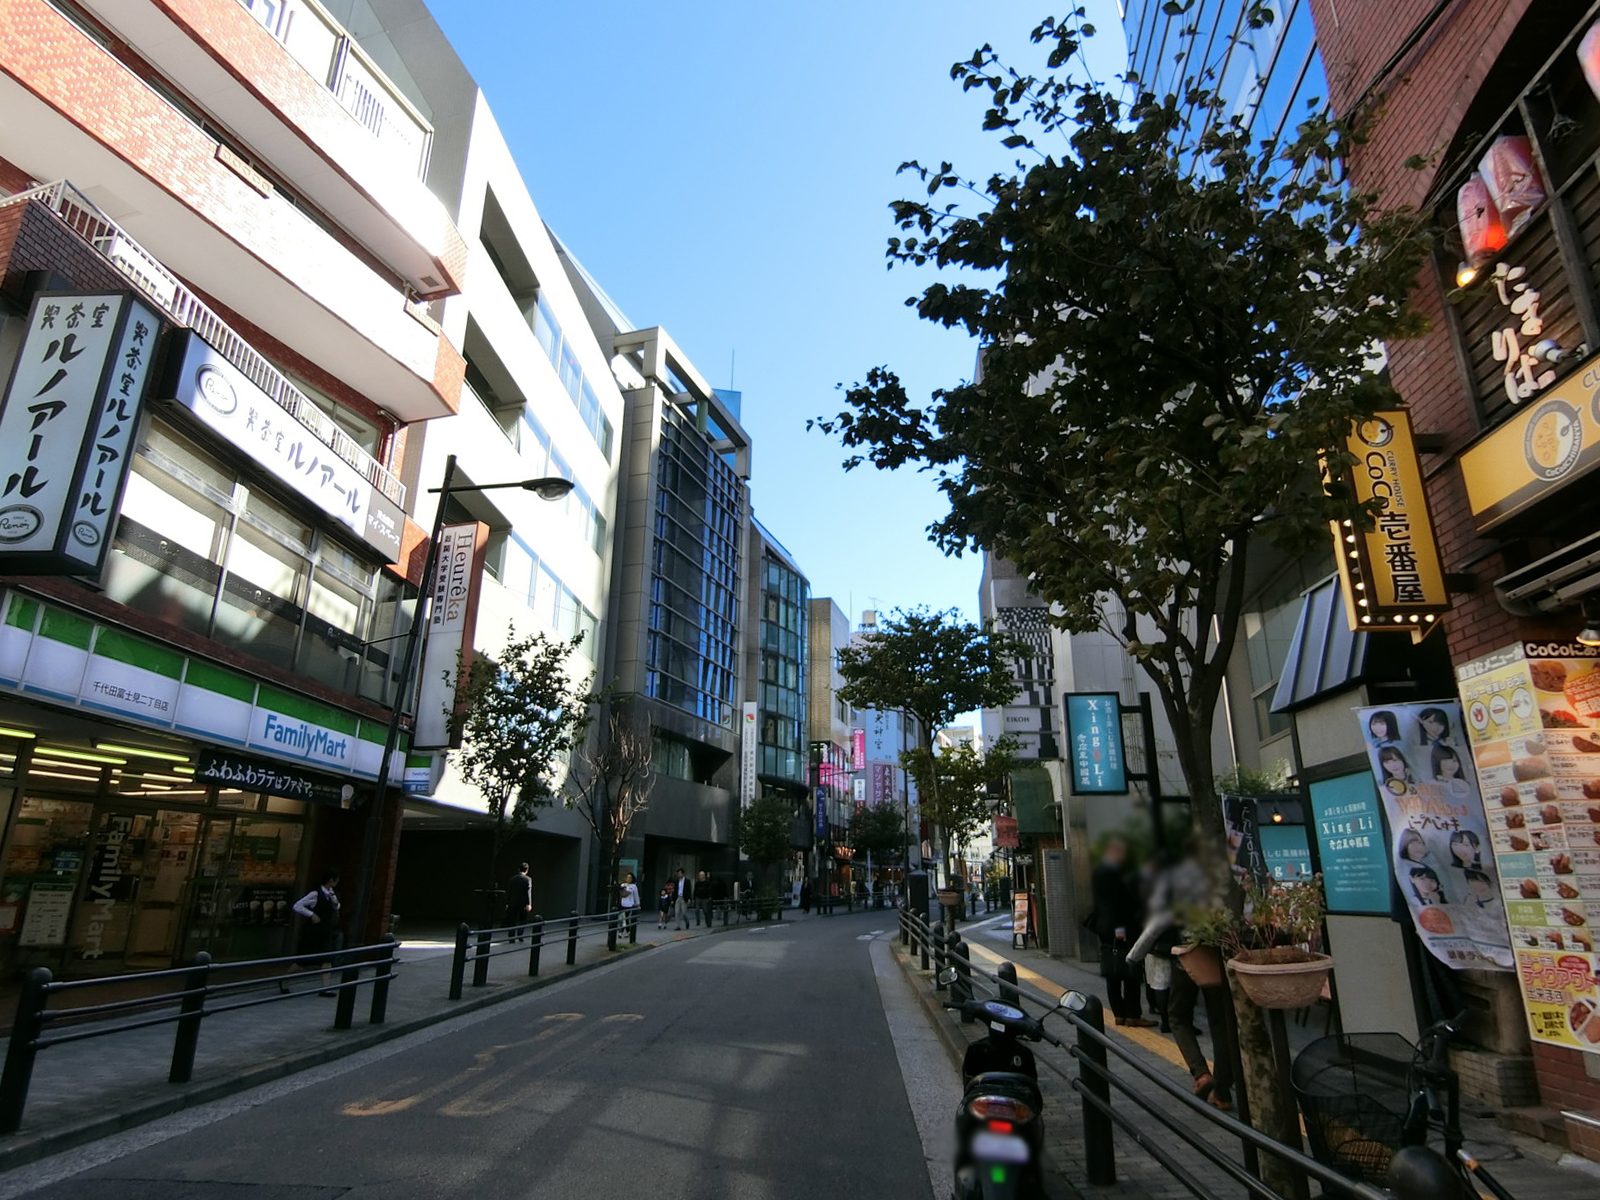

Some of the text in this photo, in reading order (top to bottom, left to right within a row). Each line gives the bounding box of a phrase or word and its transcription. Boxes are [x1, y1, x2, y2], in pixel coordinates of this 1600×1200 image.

[40, 302, 110, 330] 喫茶室
[2, 333, 87, 499] ルノアール
[1386, 450, 1405, 508] CURRY HOUSE
[446, 533, 473, 623] Heurêka
[93, 681, 170, 711] 千代田富士見二丁目店
[263, 714, 347, 760] FamilyMart
[204, 758, 314, 798] ふわふわラテはファミマ。
